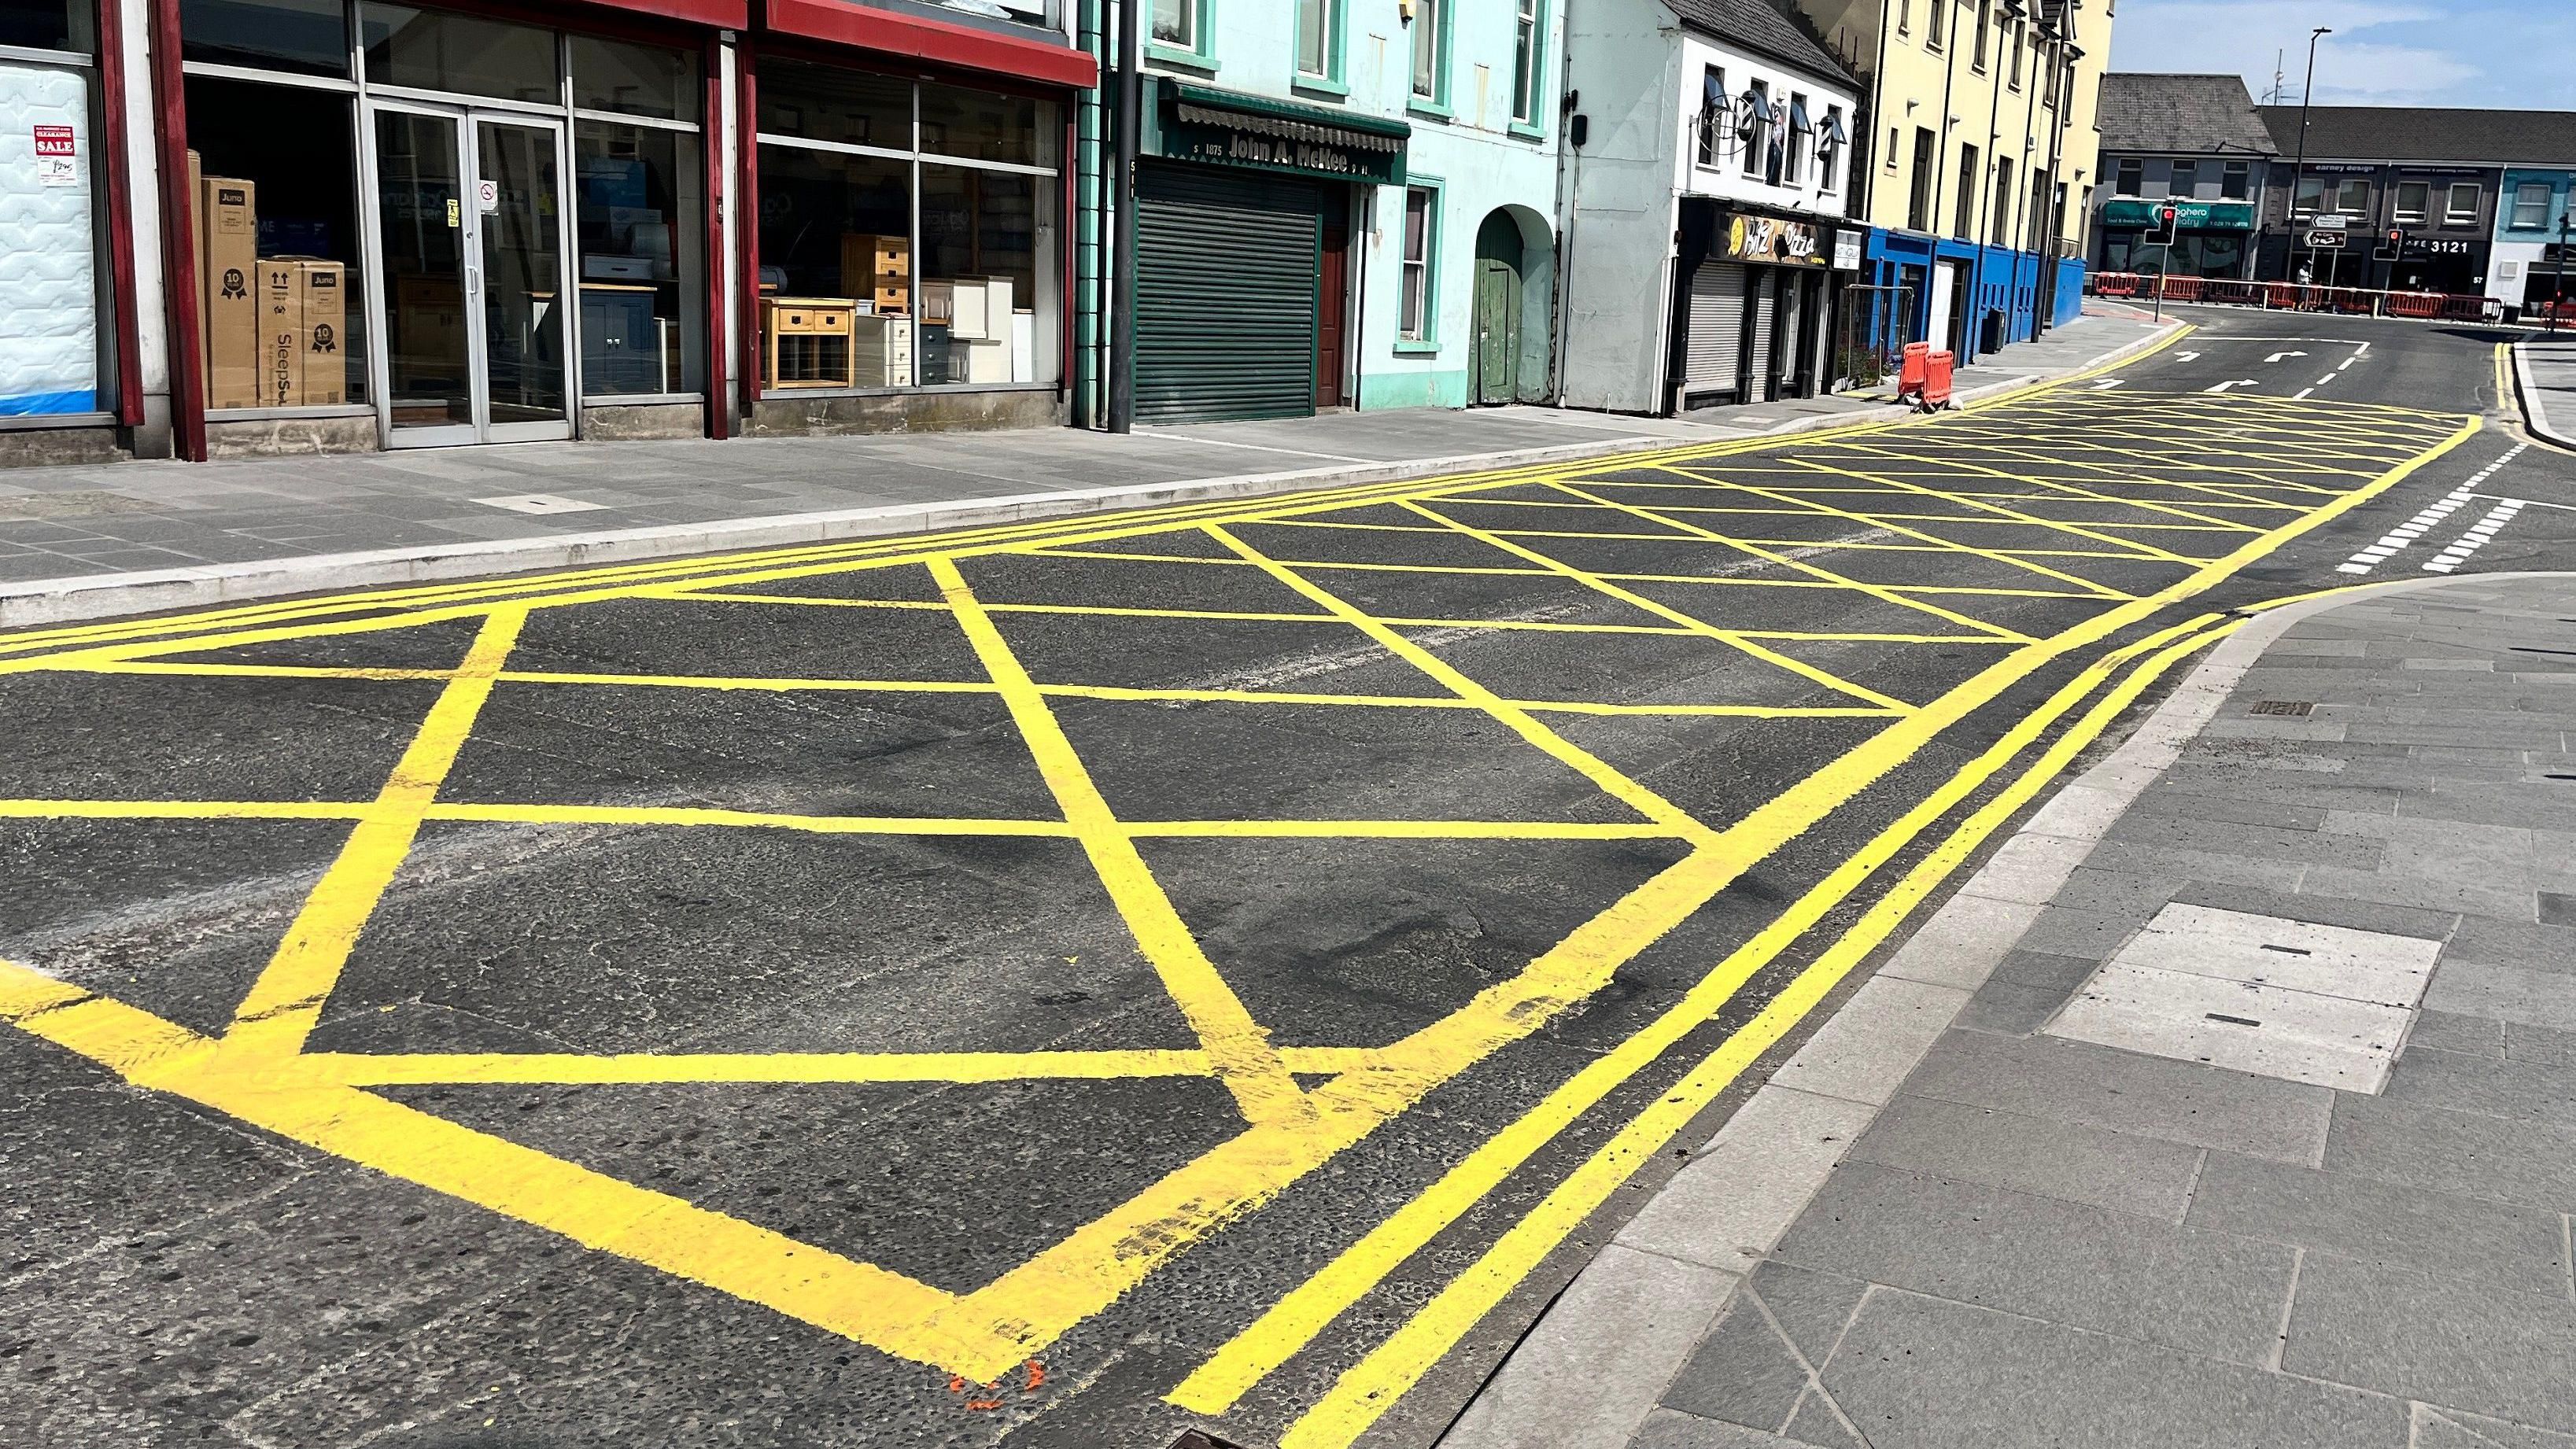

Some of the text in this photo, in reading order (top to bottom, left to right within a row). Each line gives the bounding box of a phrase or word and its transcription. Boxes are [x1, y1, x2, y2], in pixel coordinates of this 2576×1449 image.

[37, 141, 73, 152] SALE
[1206, 143, 1222, 157] 1875
[1229, 134, 1270, 161] John
[1297, 144, 1347, 172] McKee
[222, 193, 242, 202] Juno
[2430, 241, 2467, 253] 3121
[227, 273, 239, 283] 10
[316, 327, 329, 337] 10
